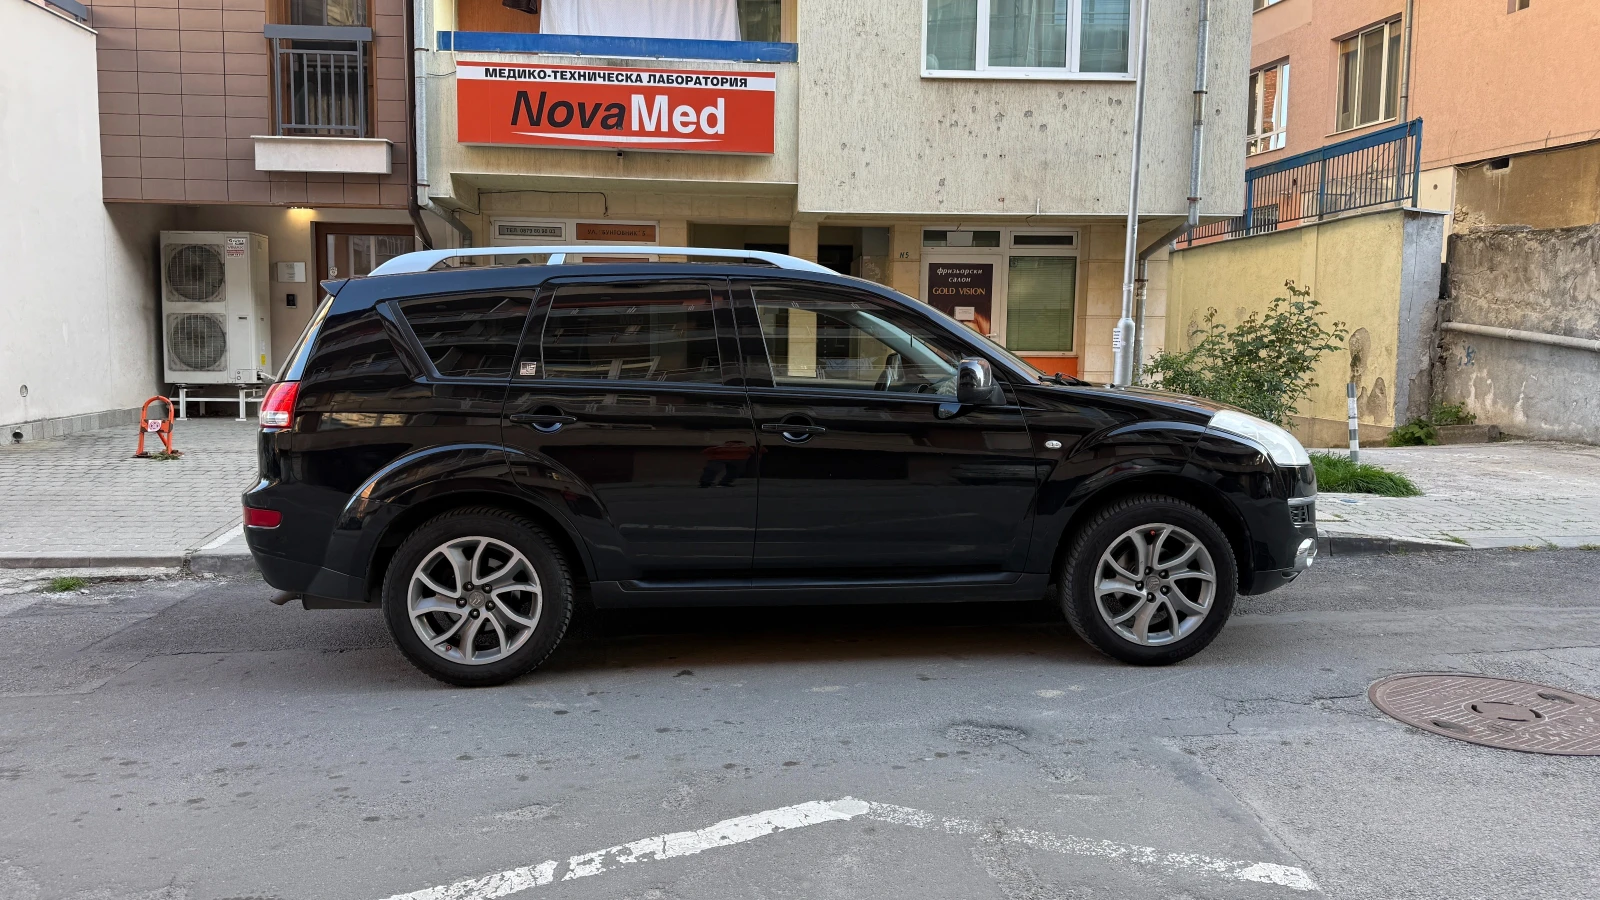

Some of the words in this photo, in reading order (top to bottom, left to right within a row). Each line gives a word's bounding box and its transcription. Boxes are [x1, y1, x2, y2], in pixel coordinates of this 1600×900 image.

[484, 67, 643, 84] МЕДИКО-ТЕХНИЧЕСКА
[647, 73, 748, 88] ЛАБОРАТОРИЯ
[510, 90, 725, 135] NovaMed
[936, 267, 983, 275] фризьорски
[932, 287, 956, 295] GOLD
[958, 287, 986, 295] VISION
